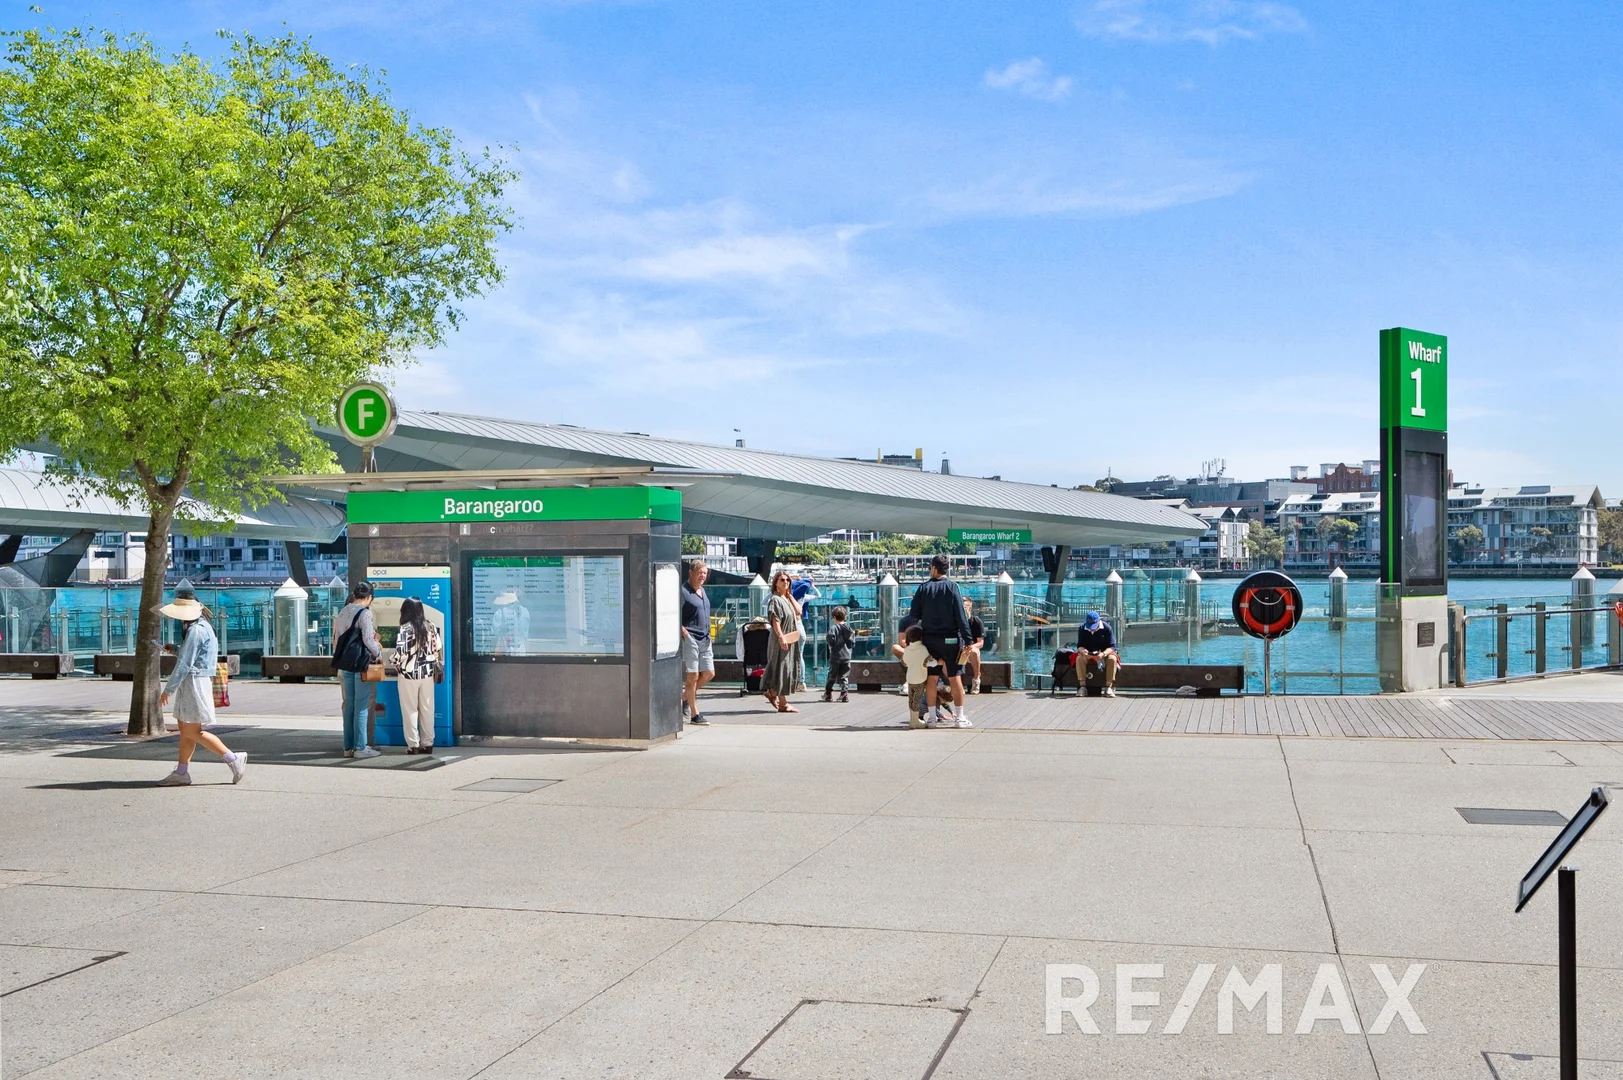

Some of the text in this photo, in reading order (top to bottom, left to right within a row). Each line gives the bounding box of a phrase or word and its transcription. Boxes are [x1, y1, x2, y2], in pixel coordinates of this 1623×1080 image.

[1408, 340, 1442, 364] Wharf
[1410, 367, 1426, 417] 1
[357, 398, 374, 430] F
[444, 498, 544, 518] Barangaroo
[962, 531, 1020, 541] Barangaroo Wharf 2
